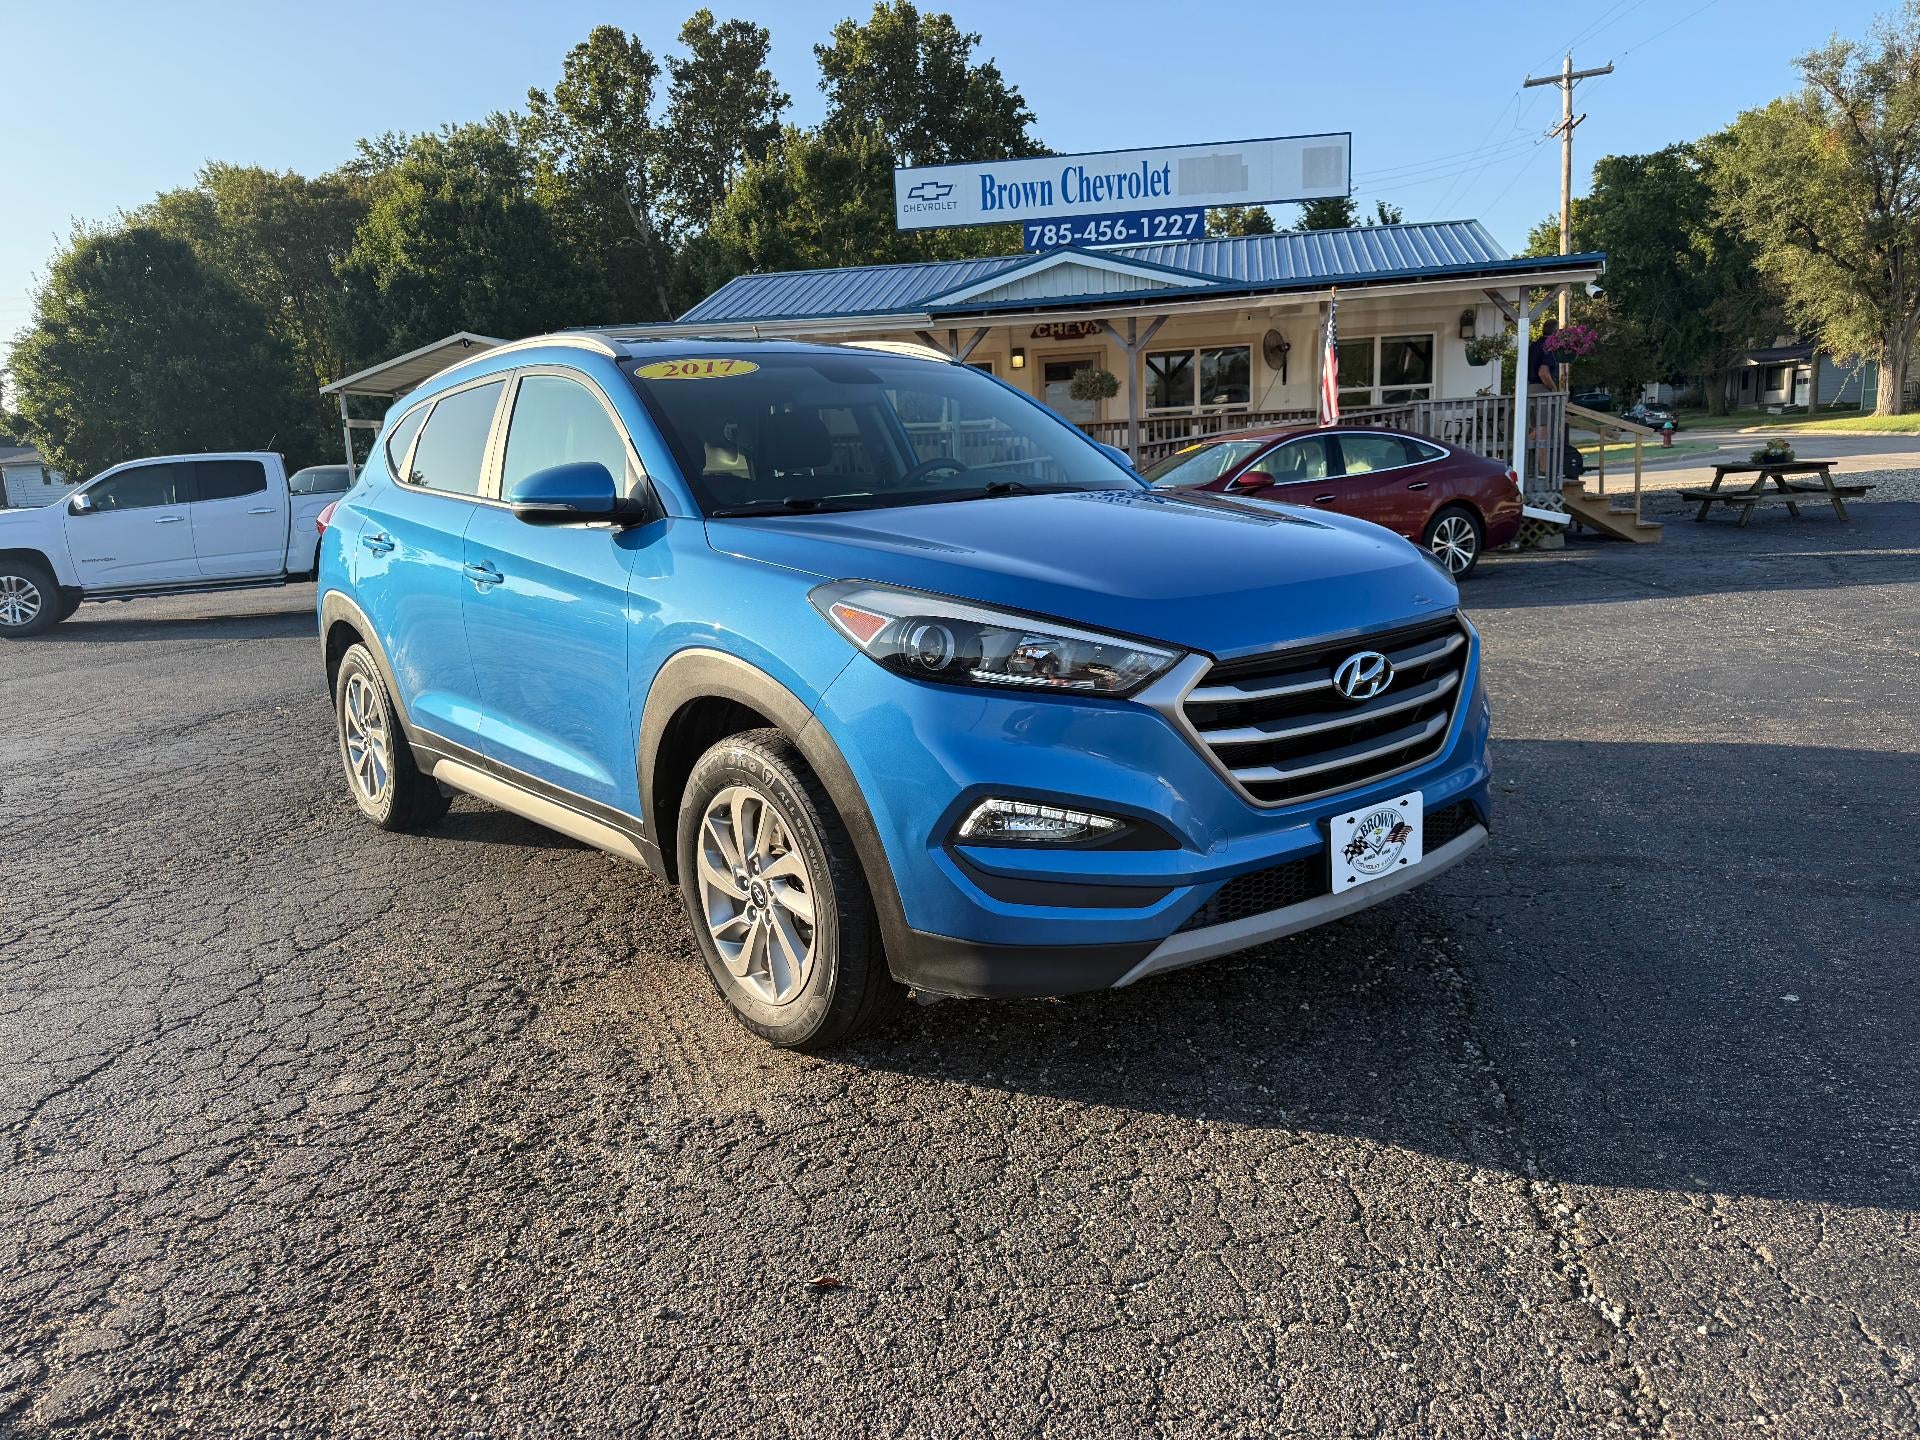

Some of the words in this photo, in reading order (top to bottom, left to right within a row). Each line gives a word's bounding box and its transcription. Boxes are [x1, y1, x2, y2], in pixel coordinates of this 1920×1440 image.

[979, 174, 1054, 211] Brown
[1061, 161, 1172, 204] Chevrolet
[903, 201, 958, 213] CHEVROLET
[1029, 214, 1199, 246] 785-456-1227
[662, 361, 735, 376] 2017
[1360, 812, 1396, 838] BROWN
